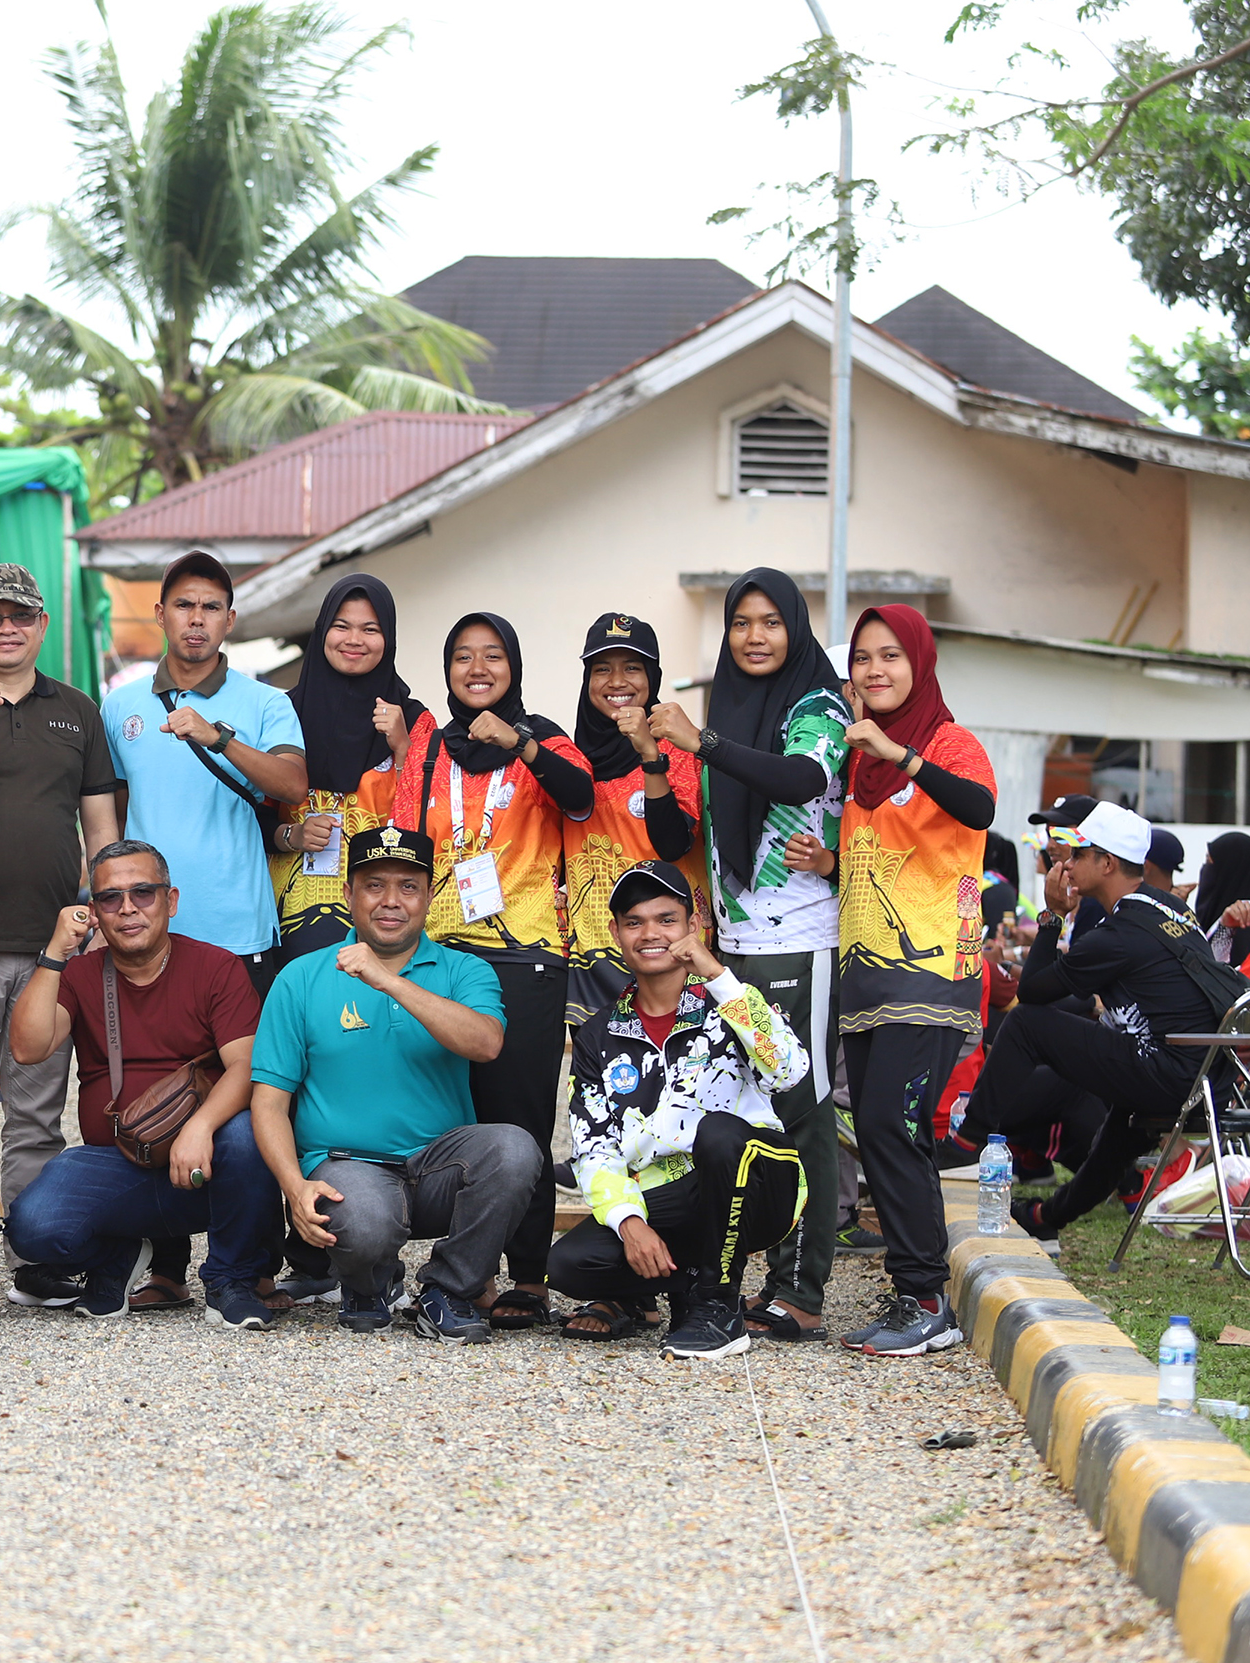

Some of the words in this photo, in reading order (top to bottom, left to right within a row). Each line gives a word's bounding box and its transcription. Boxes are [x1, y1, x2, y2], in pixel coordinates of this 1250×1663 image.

[366, 846, 388, 859] USK
[769, 978, 799, 989] EVERBLUE
[728, 1196, 745, 1227] XVII
[719, 1230, 740, 1285] POMNAS
